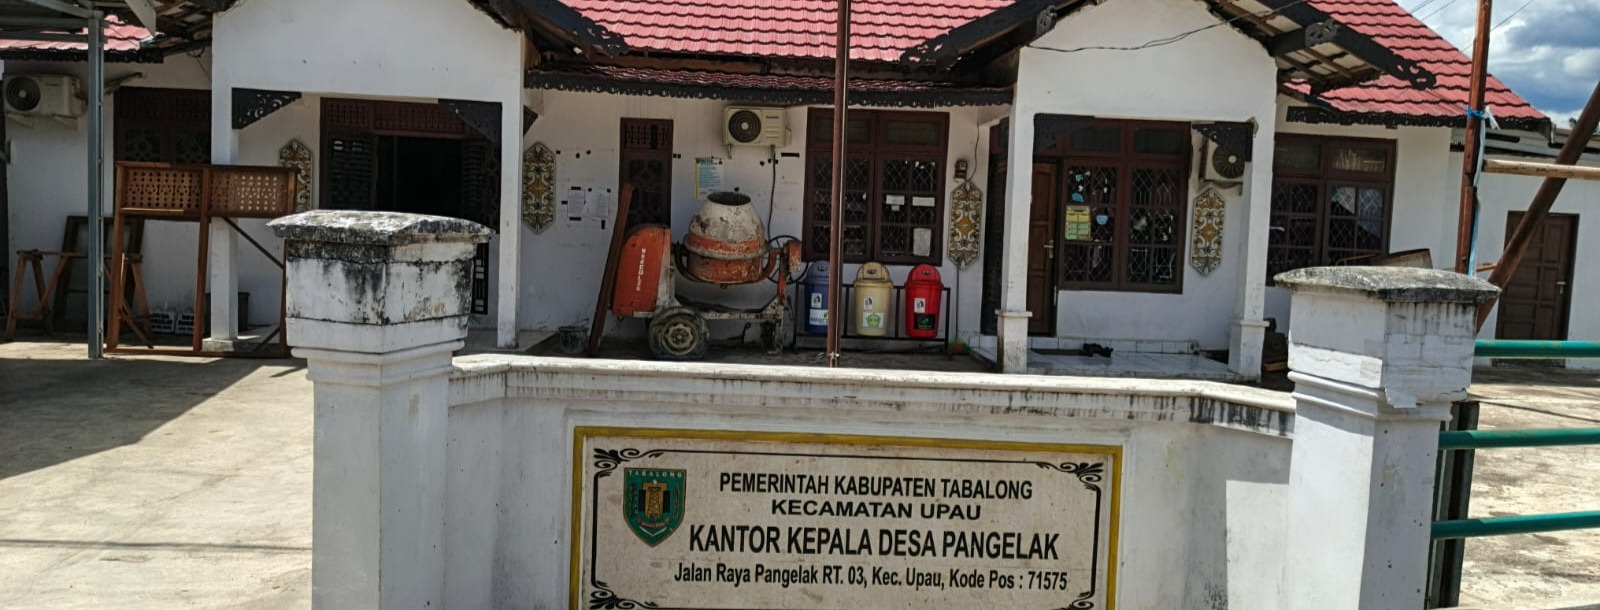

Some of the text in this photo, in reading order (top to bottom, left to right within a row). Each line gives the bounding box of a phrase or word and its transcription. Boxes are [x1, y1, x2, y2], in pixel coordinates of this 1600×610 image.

[628, 470, 683, 478] TABALONG
[719, 472, 1033, 500] PEMERINTAH KABUPATEN TABALONG
[771, 499, 981, 521] KECAMATAN UPAU
[689, 524, 1060, 561] KANTOR KEPALA DESA PANGELAK
[674, 562, 1068, 591] Jalan Raya Pangelak RT. 03, Kec. Upau, Kode Pos : 71575
